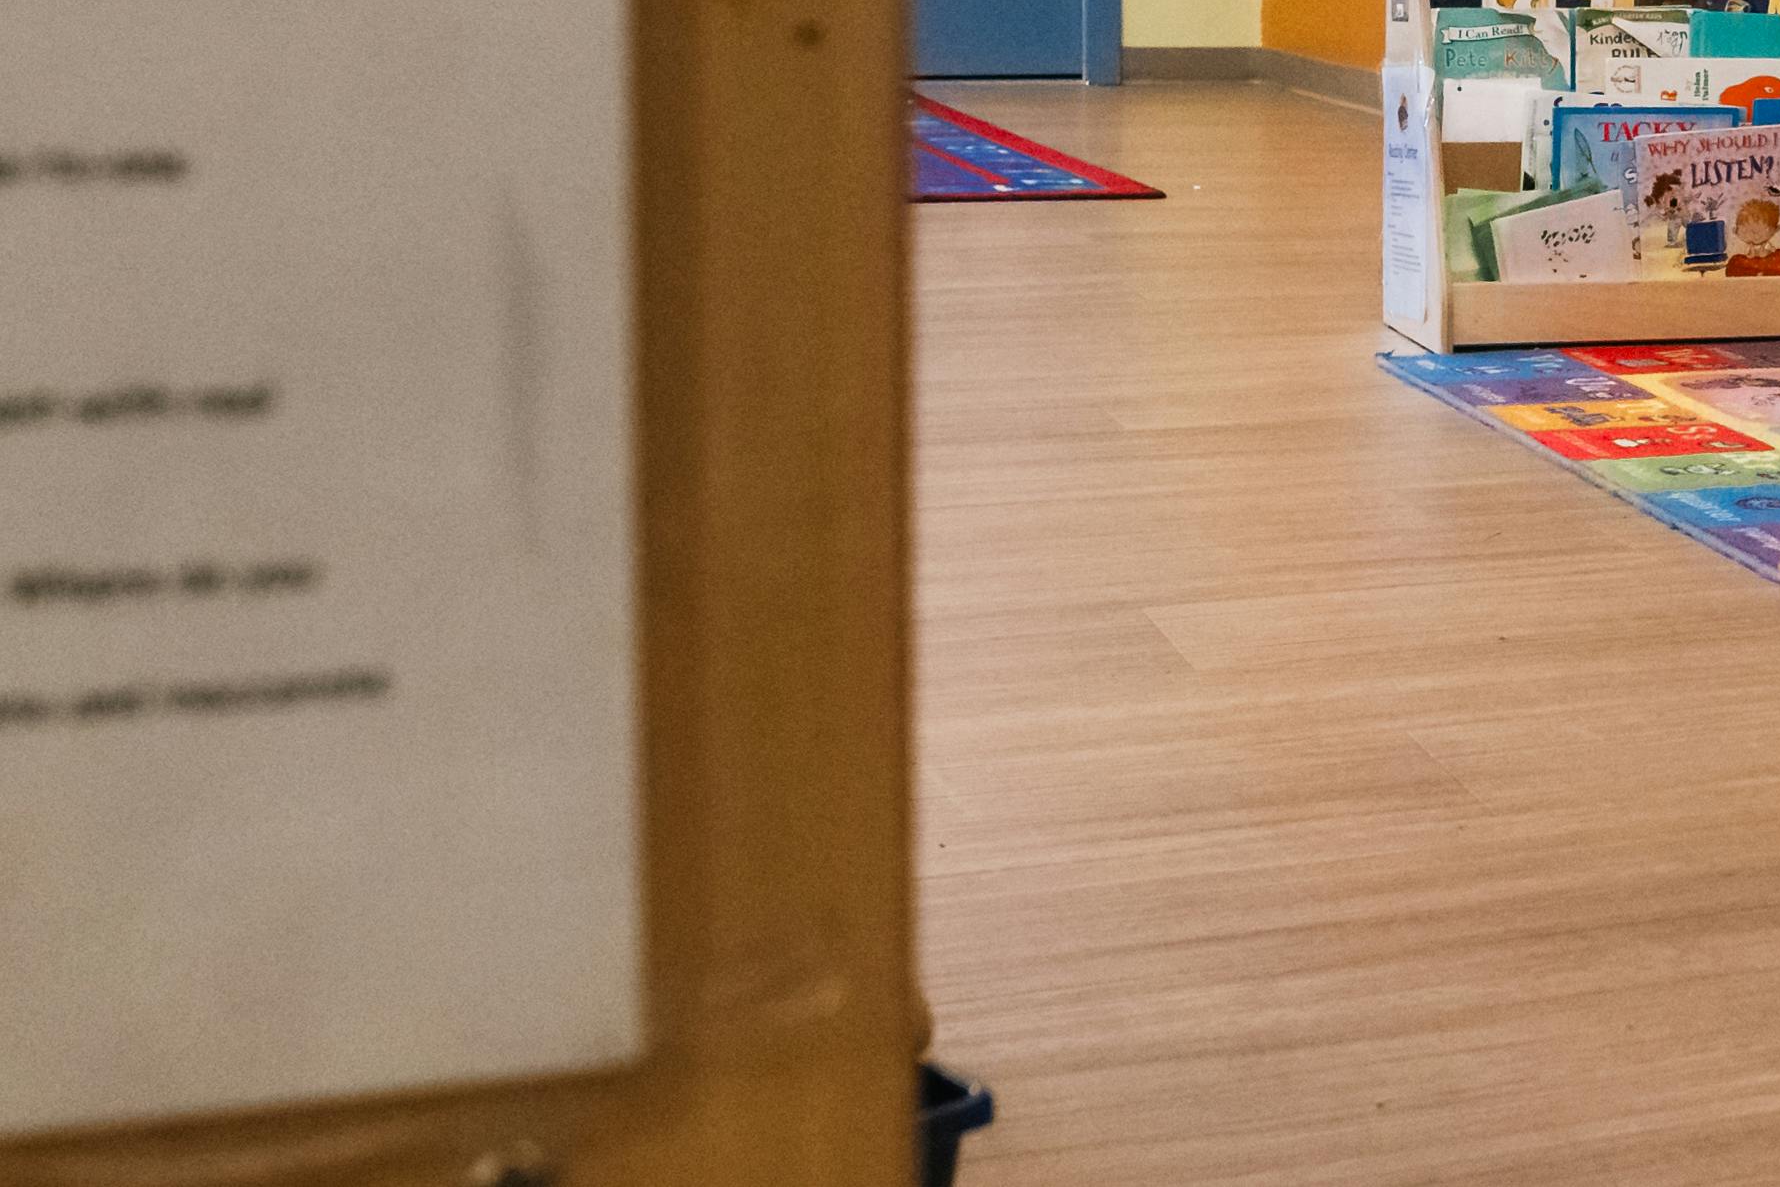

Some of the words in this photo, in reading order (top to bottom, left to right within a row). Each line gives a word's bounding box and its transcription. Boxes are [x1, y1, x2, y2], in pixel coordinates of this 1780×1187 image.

[1465, 28, 1489, 40] Can
[1491, 24, 1524, 37] Read!
[1445, 47, 1489, 68] Pete
[1505, 48, 1559, 75] Kitty
[1647, 138, 1691, 158] WHY
[1698, 133, 1769, 154] SHOULD
[1773, 131, 1779, 147] I
[1691, 155, 1774, 189] LISTEN?
